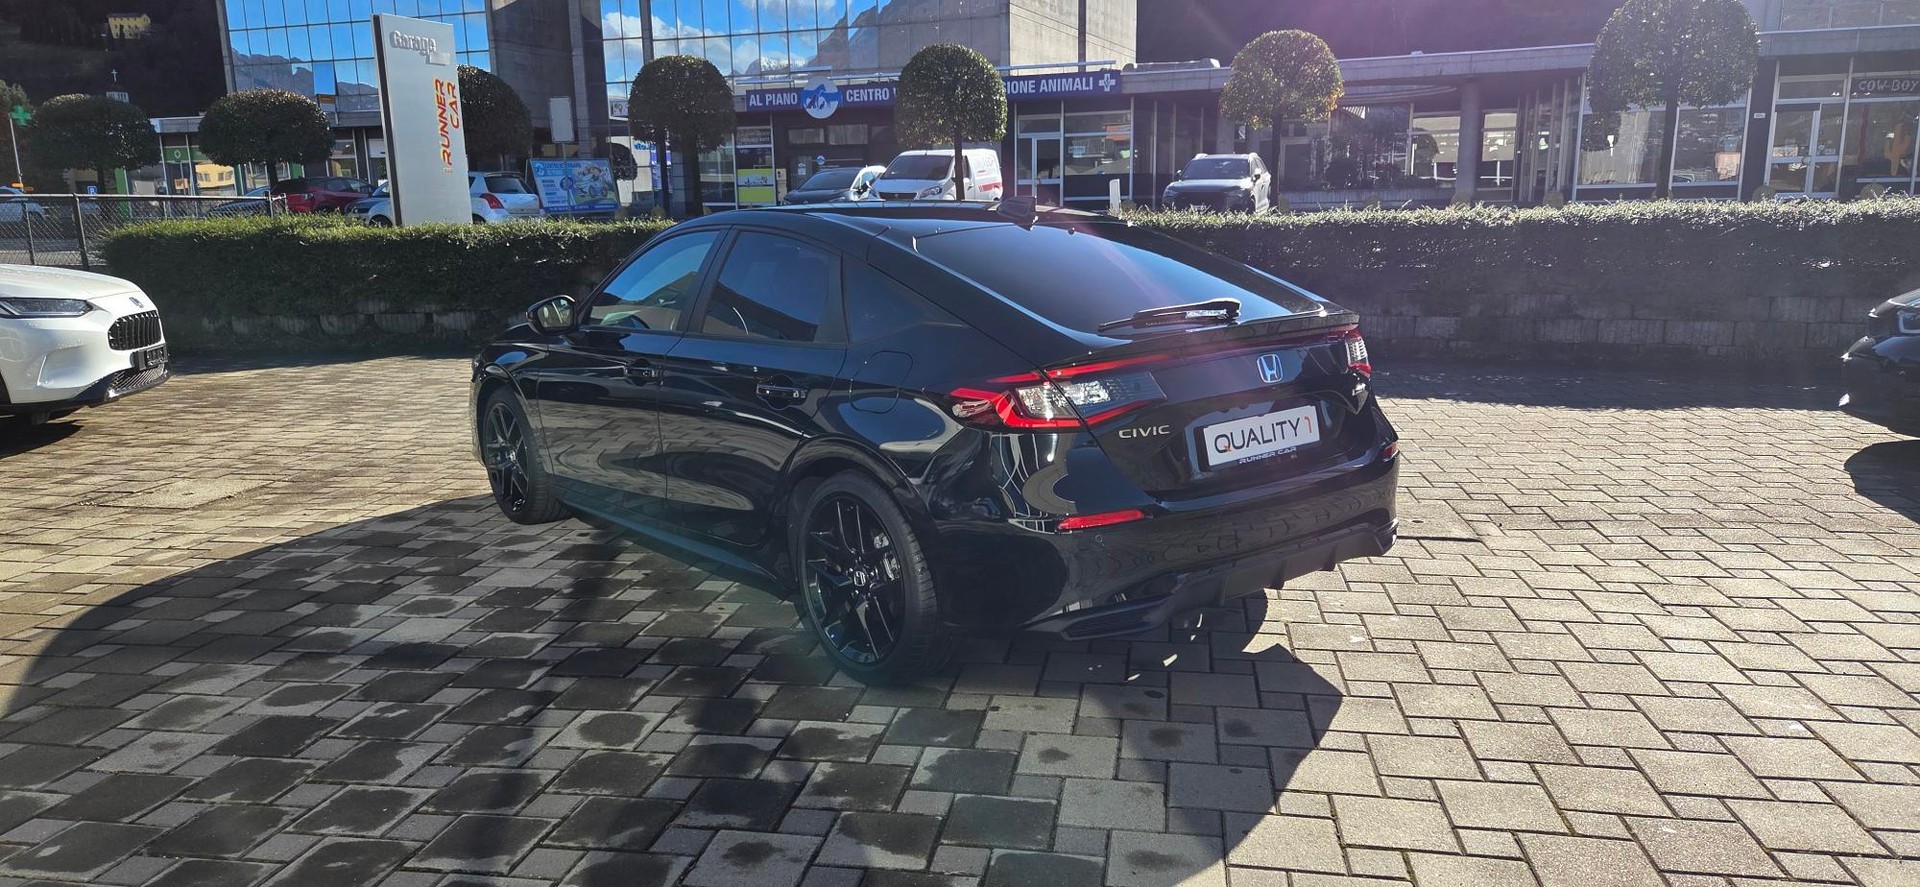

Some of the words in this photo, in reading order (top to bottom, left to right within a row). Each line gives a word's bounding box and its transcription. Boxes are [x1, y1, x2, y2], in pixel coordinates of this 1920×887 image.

[392, 30, 437, 56] Garage
[1039, 76, 1093, 93] ANIMALI
[1859, 79, 1919, 92] COW-BOY
[447, 82, 460, 129] CAR
[749, 94, 762, 107] AL
[765, 92, 798, 106] PIANO
[846, 87, 890, 102] CENTRO
[434, 78, 452, 166] RUNNER
[1118, 424, 1171, 439] CIVIC
[1214, 417, 1300, 454] QUALITY
[1304, 416, 1312, 434] 1
[1239, 451, 1276, 464] RUNNER
[1278, 446, 1297, 456] CAR
